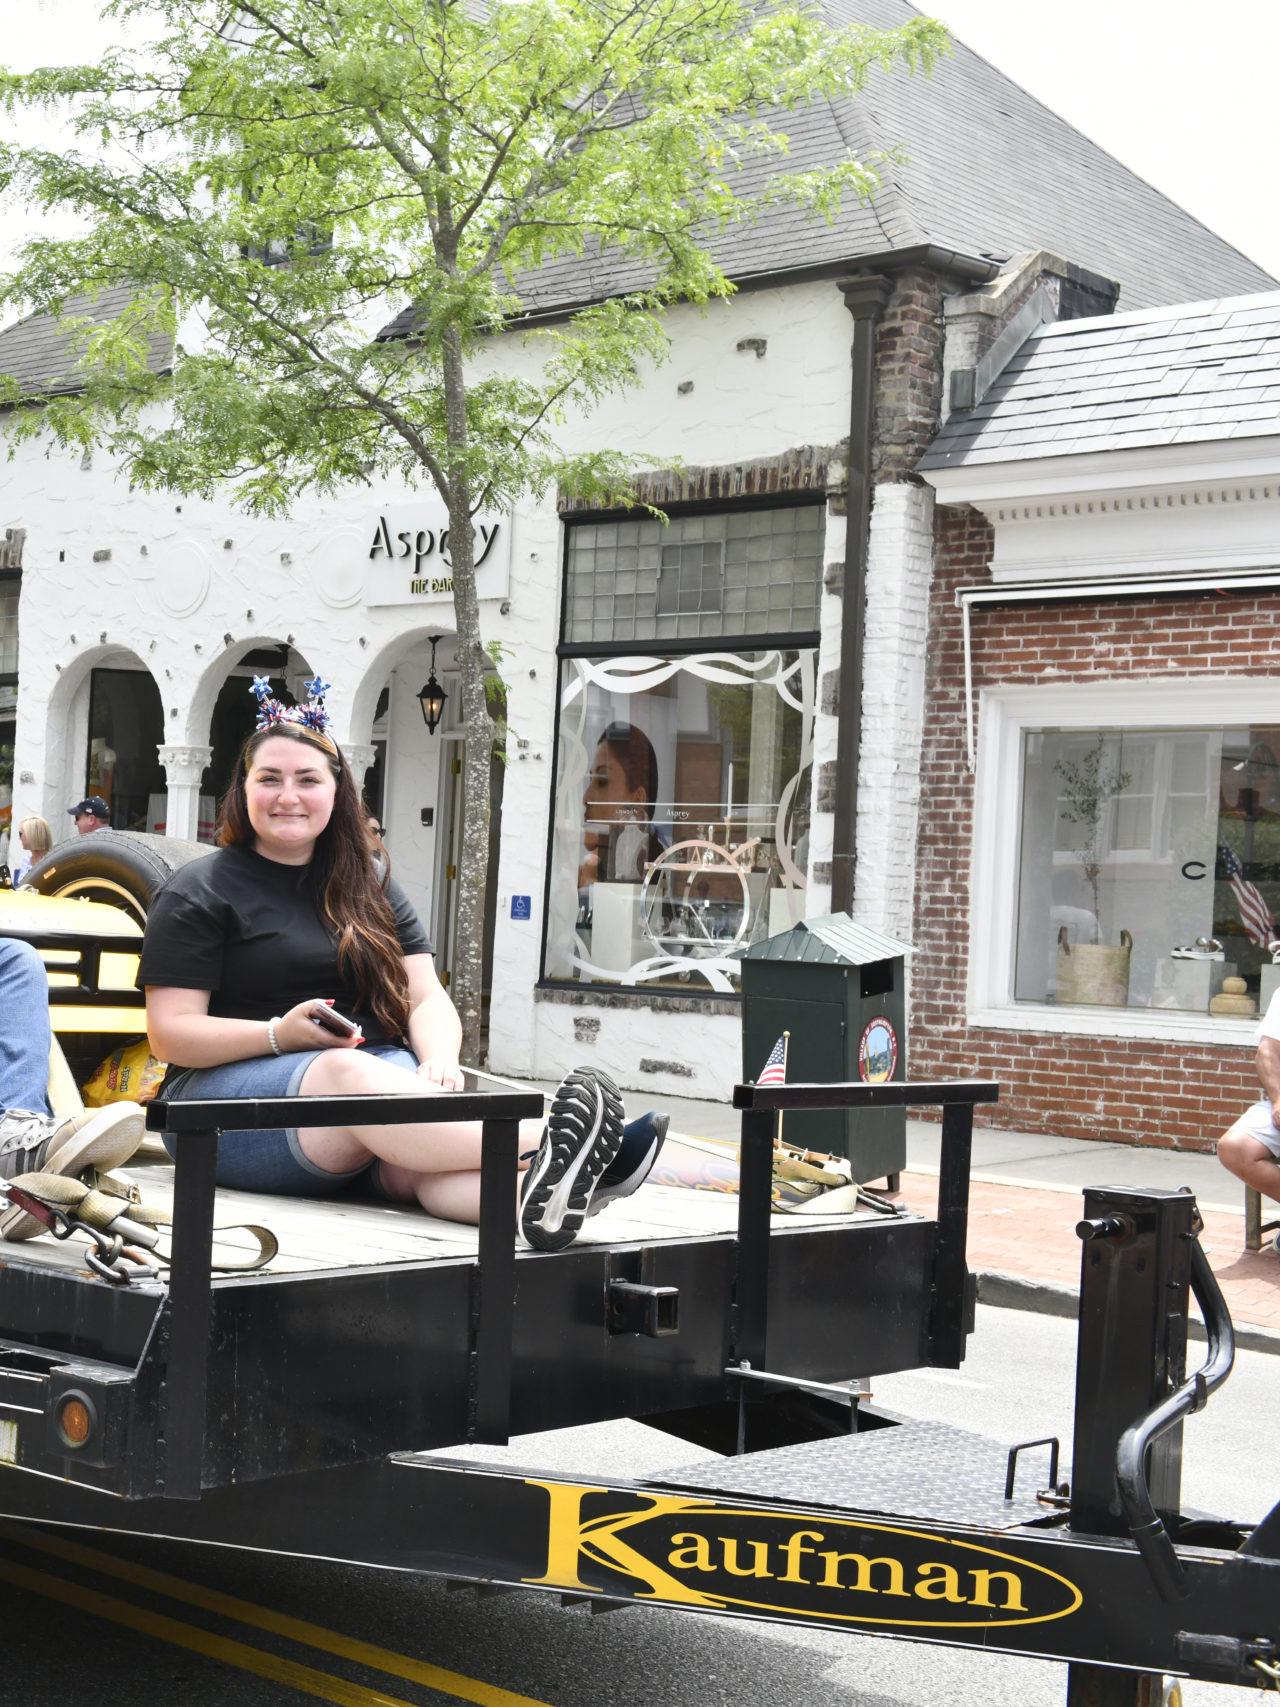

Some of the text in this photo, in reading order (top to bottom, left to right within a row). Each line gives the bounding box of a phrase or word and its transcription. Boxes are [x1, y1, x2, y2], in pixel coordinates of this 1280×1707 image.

[369, 515, 500, 574] Aspry
[409, 578, 428, 594] THE
[666, 808, 690, 820] Asprey
[521, 1479, 1028, 1611] Kaufman
